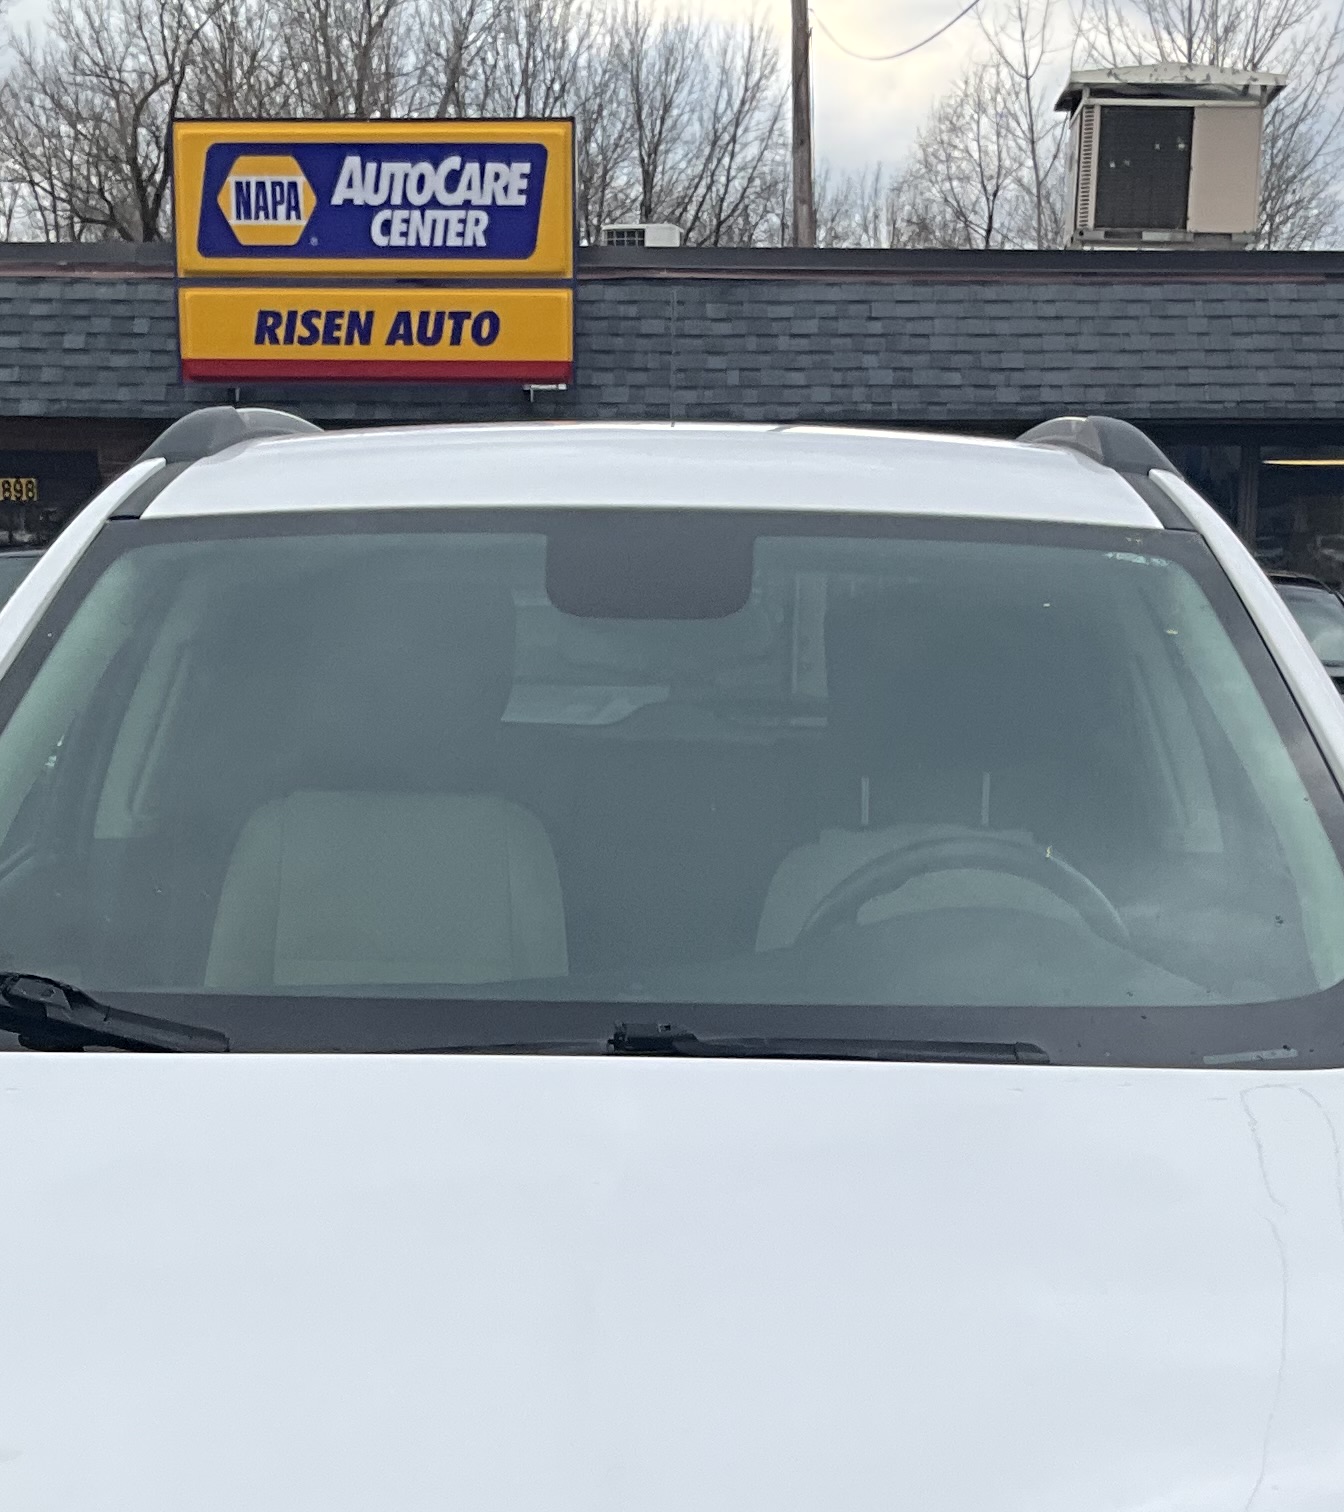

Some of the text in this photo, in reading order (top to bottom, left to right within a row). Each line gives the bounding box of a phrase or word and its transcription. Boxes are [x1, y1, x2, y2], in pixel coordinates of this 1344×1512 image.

[236, 181, 302, 221] NAPA
[370, 209, 488, 247] CENTER
[255, 309, 501, 347] RISEN AUTO
